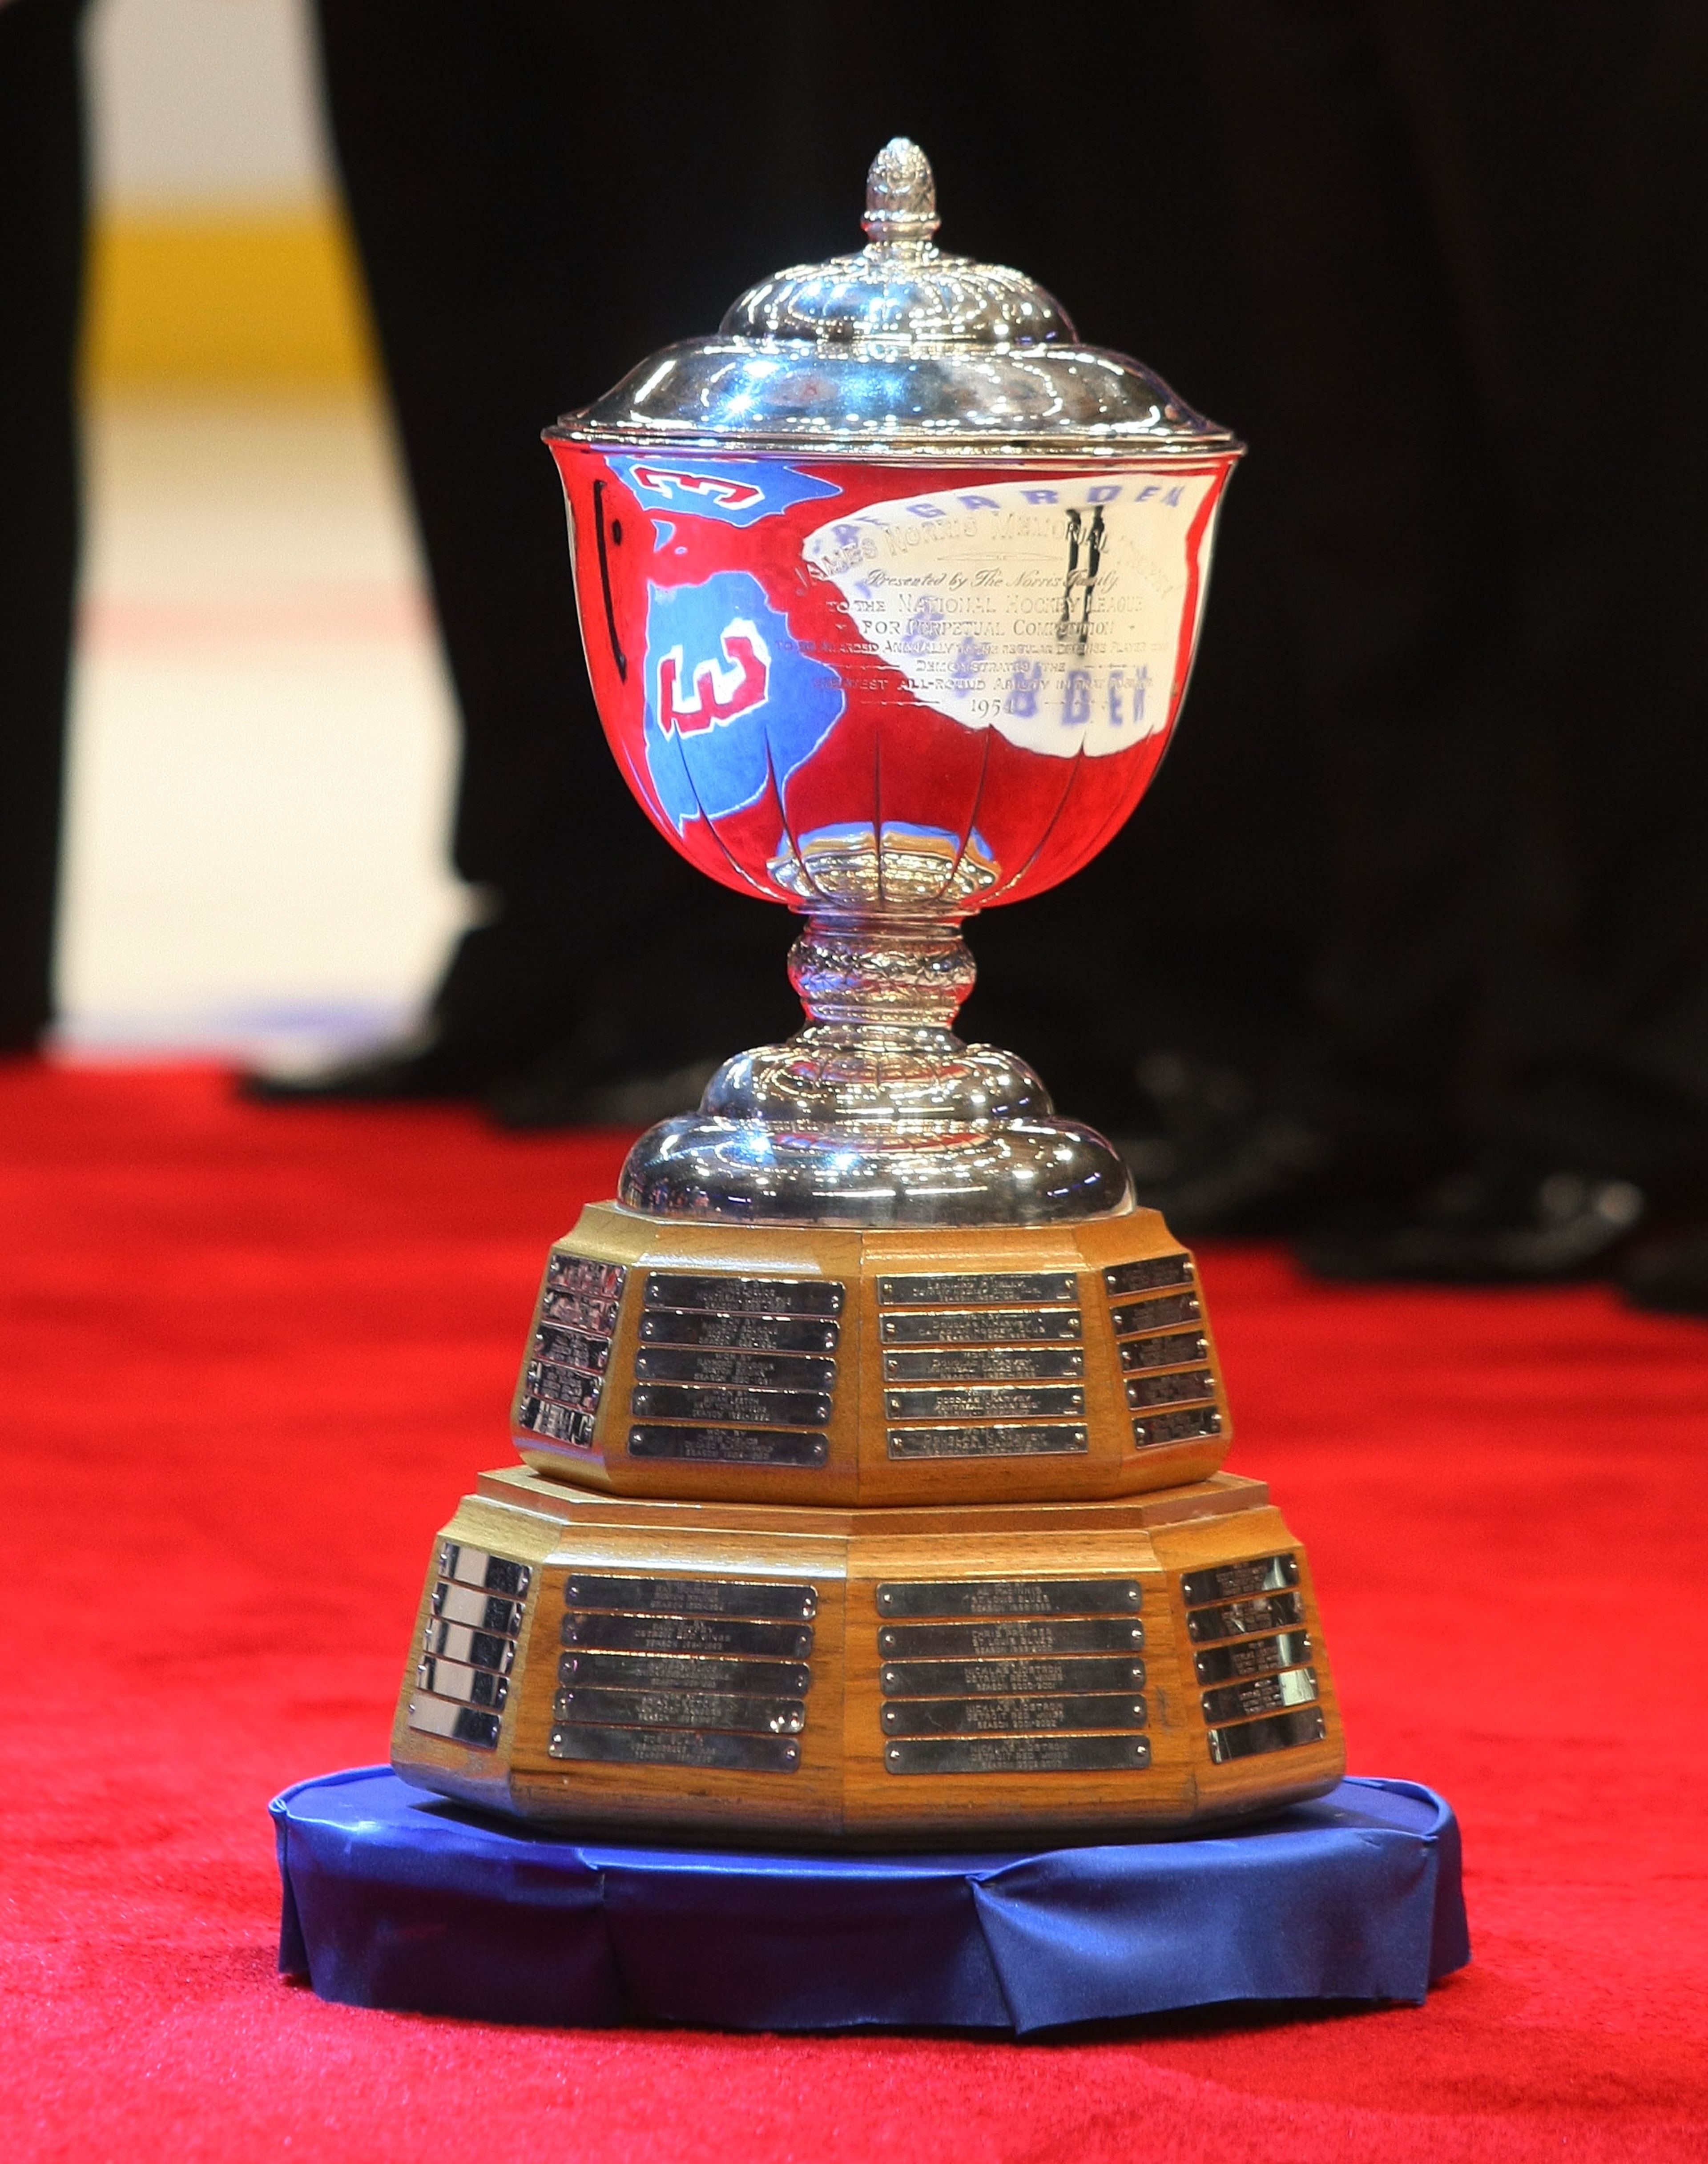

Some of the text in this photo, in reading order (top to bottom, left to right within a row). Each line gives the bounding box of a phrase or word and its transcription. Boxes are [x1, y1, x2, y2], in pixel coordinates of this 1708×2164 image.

[867, 569, 947, 587] Presented
[950, 571, 968, 591] by
[971, 568, 1003, 587] The
[1006, 569, 1063, 588] Norris
[854, 600, 886, 613] THE
[899, 594, 997, 613] NATIONAL
[1006, 595, 1080, 614] HOCKEY
[862, 620, 902, 635] FOR
[906, 619, 1006, 636] PERPETUAL
[971, 700, 1016, 718] 1954
